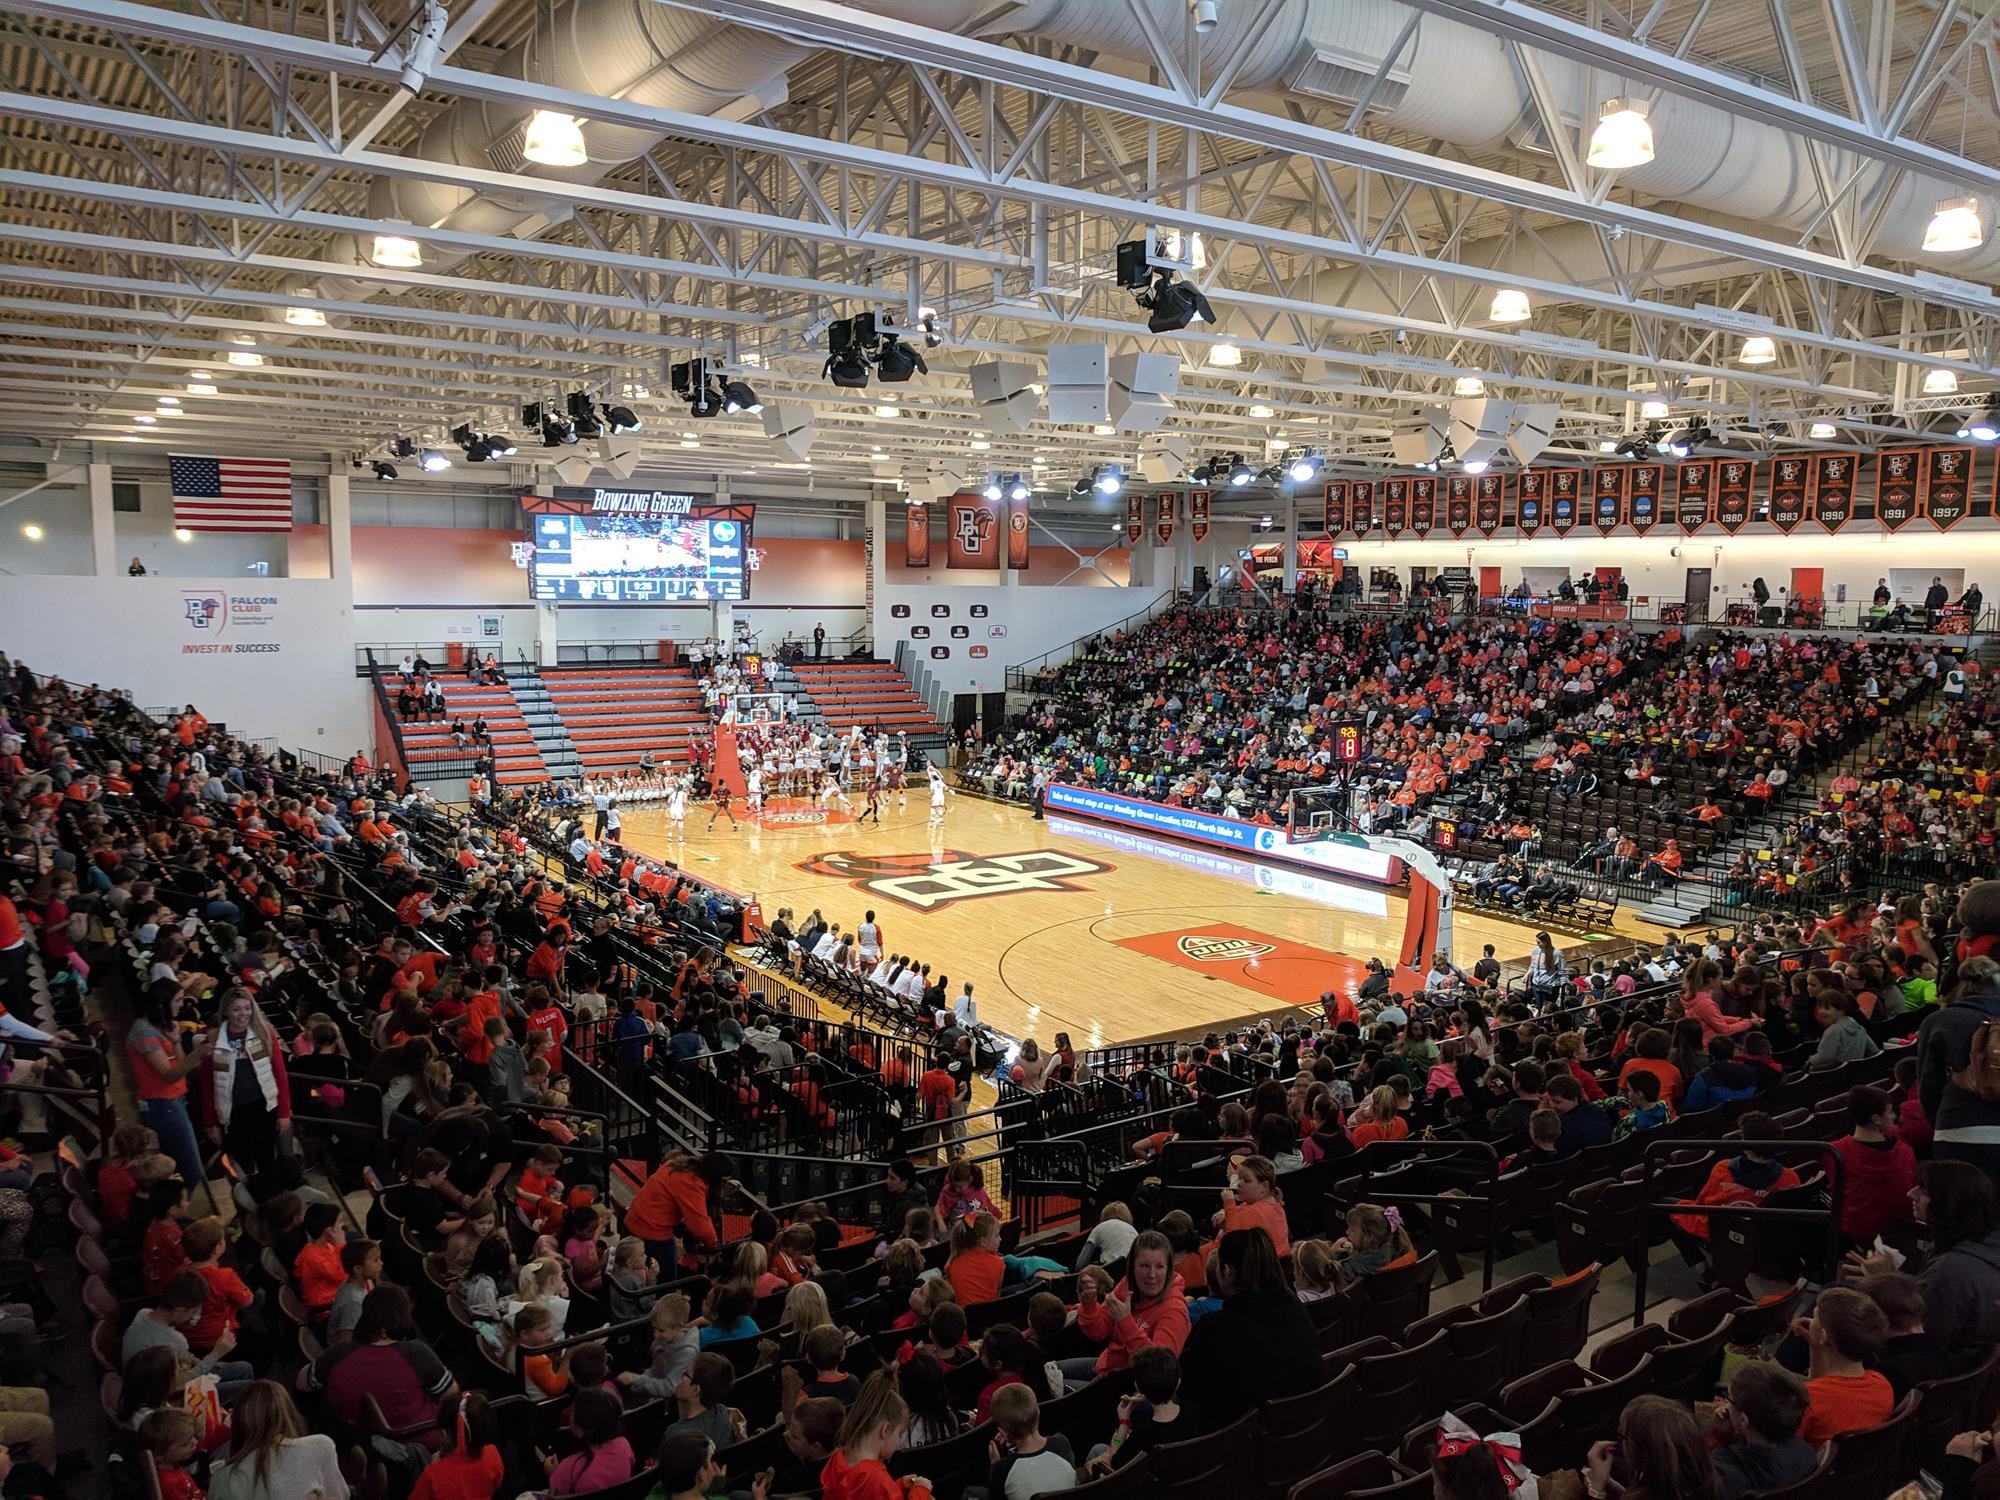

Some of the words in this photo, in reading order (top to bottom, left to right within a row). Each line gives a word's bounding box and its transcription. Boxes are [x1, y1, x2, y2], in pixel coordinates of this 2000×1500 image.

[591, 489, 651, 512] BOWLING
[651, 491, 694, 514] GREEN
[1776, 512, 1799, 521] 1983
[1821, 511, 1845, 520] 1990
[1884, 509, 1906, 519] 1991
[1933, 507, 1960, 518] 1997
[1554, 518, 1572, 526] 1962
[1597, 517, 1616, 525] 1963
[1633, 516, 1652, 525] 1968
[1682, 515, 1703, 523] 1975
[1722, 513, 1743, 522] 1980
[1387, 522, 1402, 530] 1946
[1480, 520, 1496, 528] 1954
[1521, 519, 1538, 527] 1959
[231, 597, 278, 605] FALCON
[182, 644, 219, 654] INVEST
[221, 644, 233, 653] IN
[234, 644, 280, 653] SUCCESS
[1340, 726, 1357, 738] 9:26
[1346, 738, 1355, 758] 8
[1051, 790, 1063, 800] Take
[1113, 804, 1137, 818] Bowling
[1137, 809, 1155, 820] Green
[1196, 821, 1216, 833] North
[1216, 825, 1233, 837] Main
[1443, 833, 1451, 845] 8
